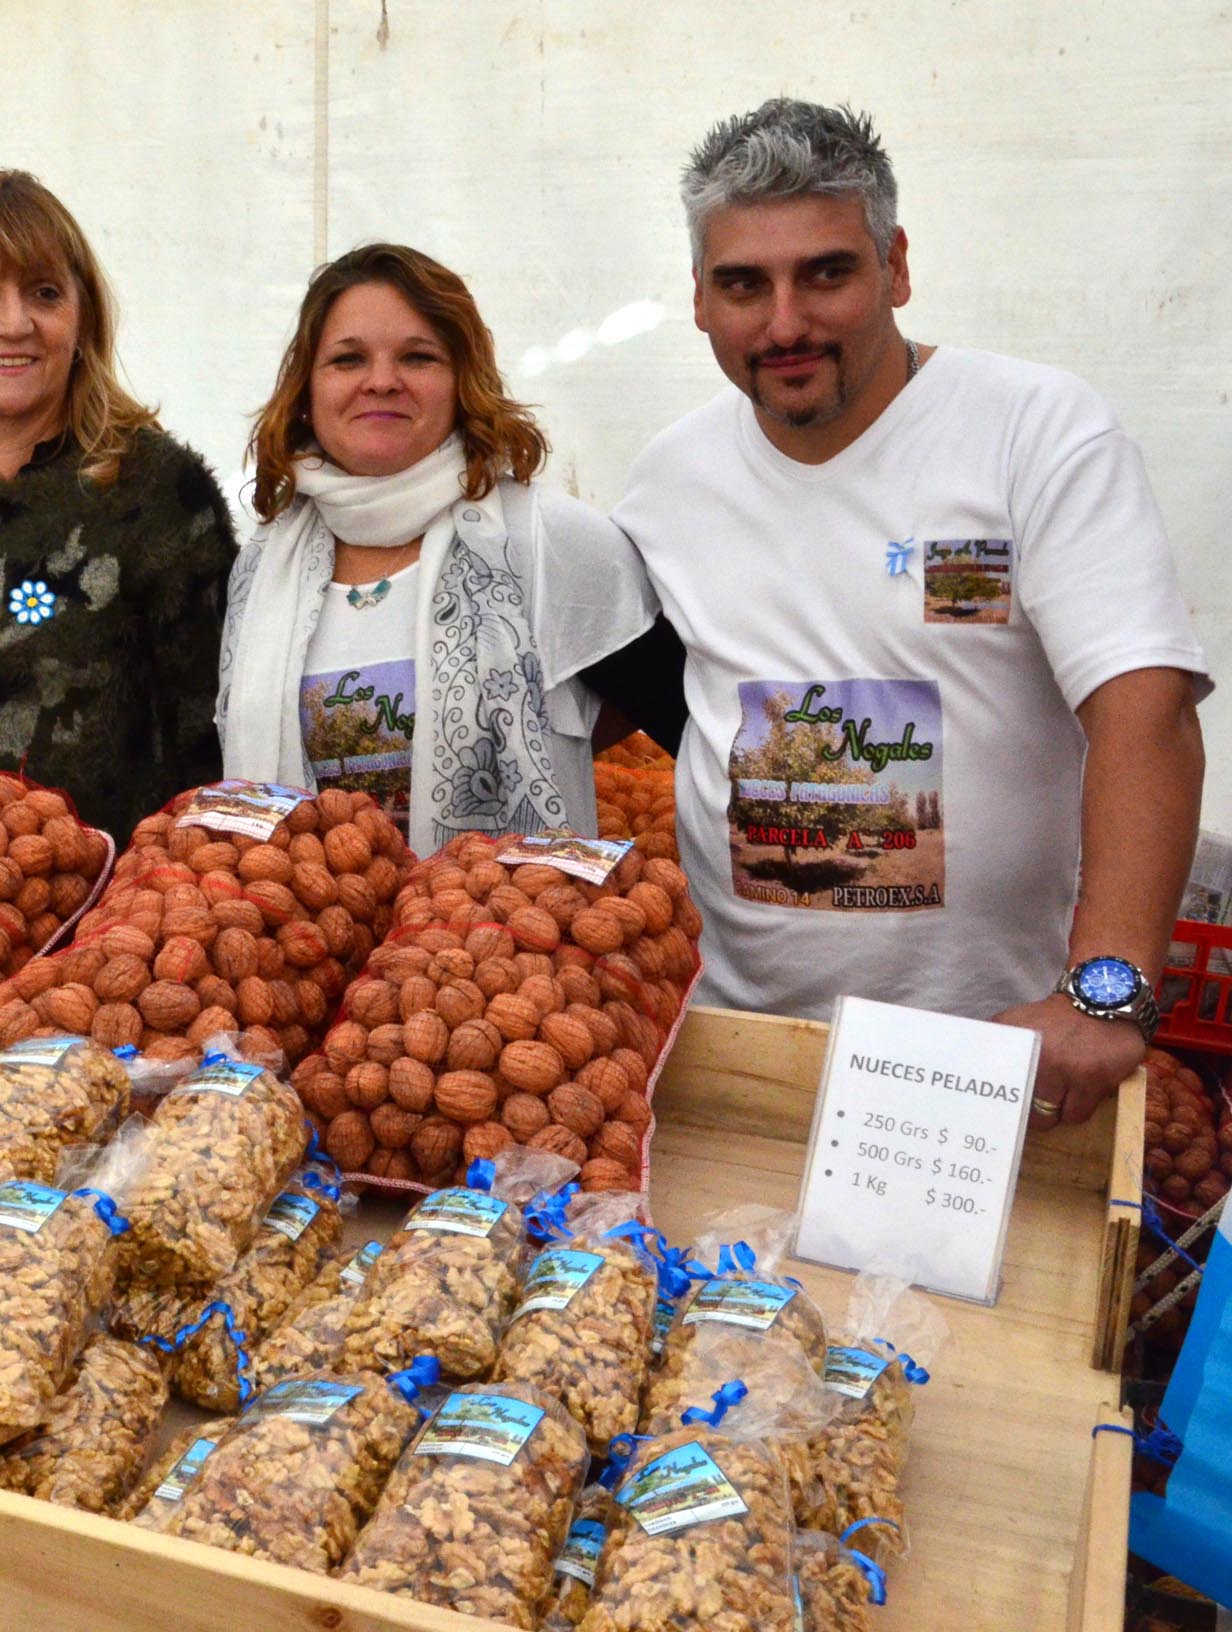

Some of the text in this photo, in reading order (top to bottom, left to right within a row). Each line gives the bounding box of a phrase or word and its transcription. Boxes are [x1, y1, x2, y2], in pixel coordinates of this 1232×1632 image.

[323, 671, 375, 708] Los
[784, 684, 843, 724] Los
[822, 718, 933, 773] Nogales
[746, 824, 916, 850] PARCELA A 206
[849, 1053, 1021, 1104] NUECES PELADAS
[863, 1112, 997, 1155] 250 Grs $ 90.-
[857, 1141, 992, 1185] 500 Grs $ 160.-
[851, 1172, 987, 1215] 1 Kg $ 300.-
